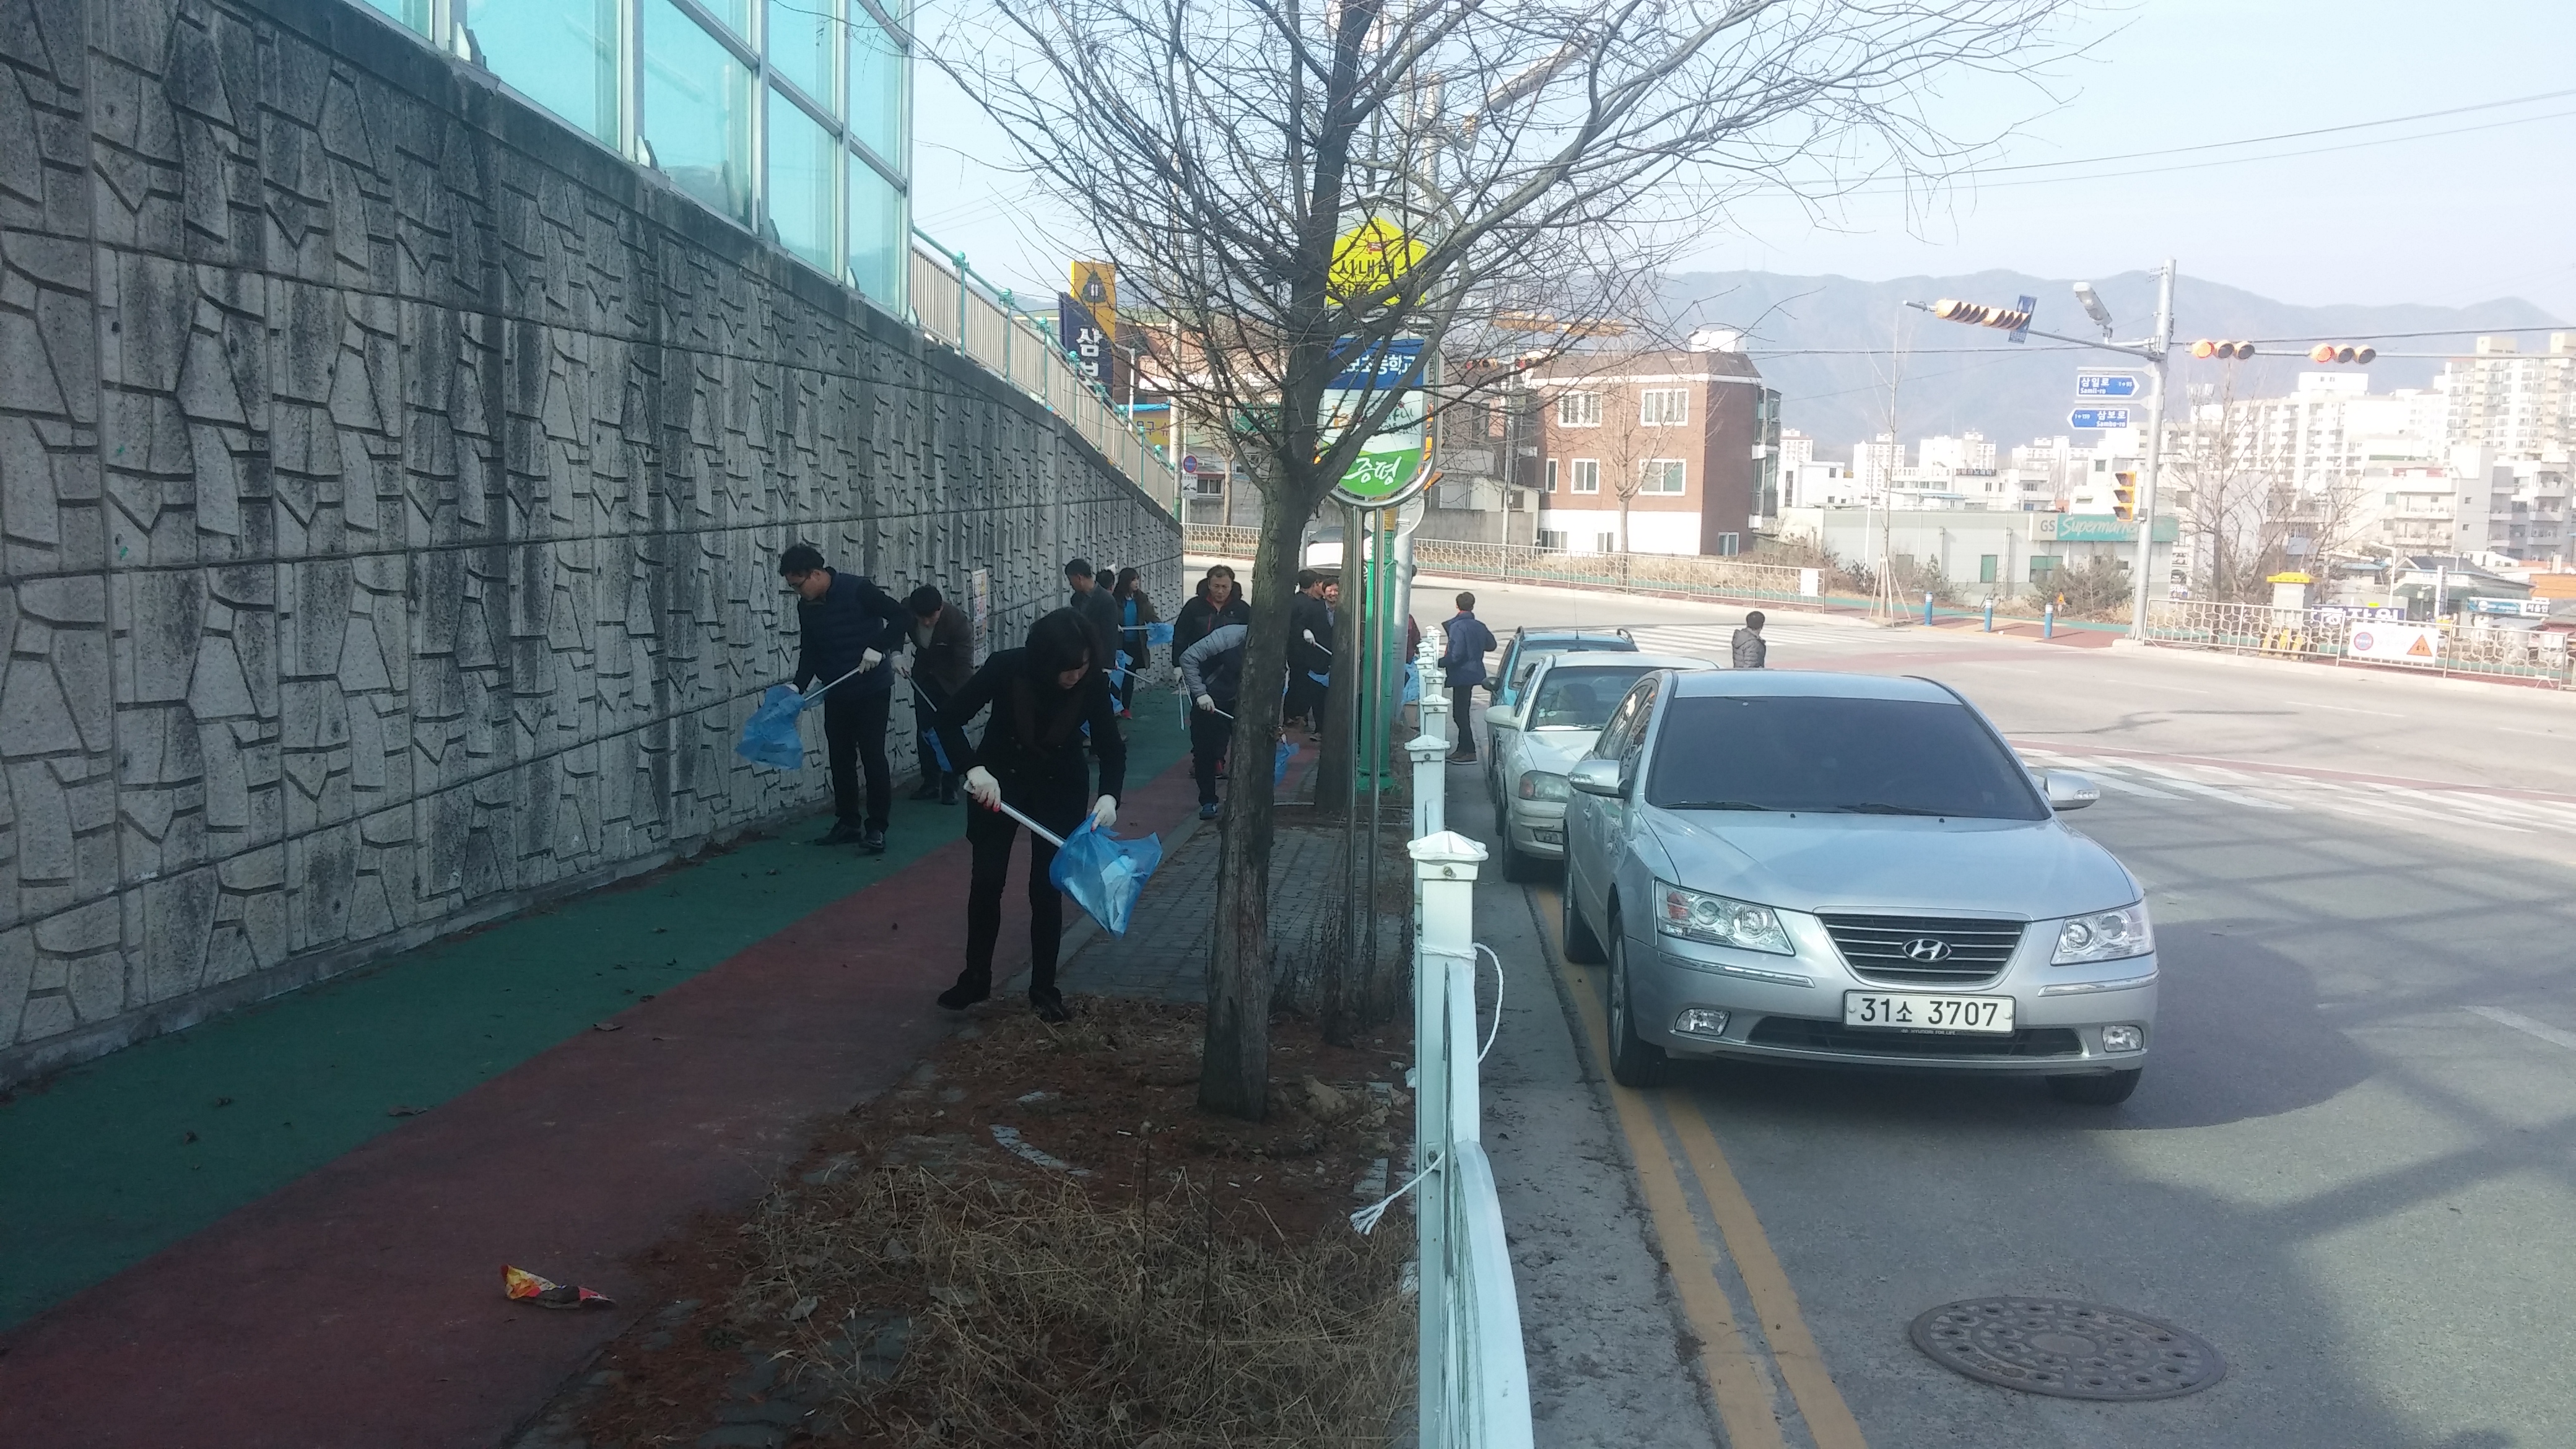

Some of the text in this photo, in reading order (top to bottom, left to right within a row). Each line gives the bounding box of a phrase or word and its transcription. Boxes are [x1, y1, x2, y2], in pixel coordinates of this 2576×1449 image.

[2081, 377, 2110, 388] 삼일로
[2097, 411, 2126, 420] 삼보로
[1341, 456, 1402, 485] 증평
[2040, 516, 2139, 537] GS Supermarke
[1860, 998, 1998, 1027] 31소 3707
